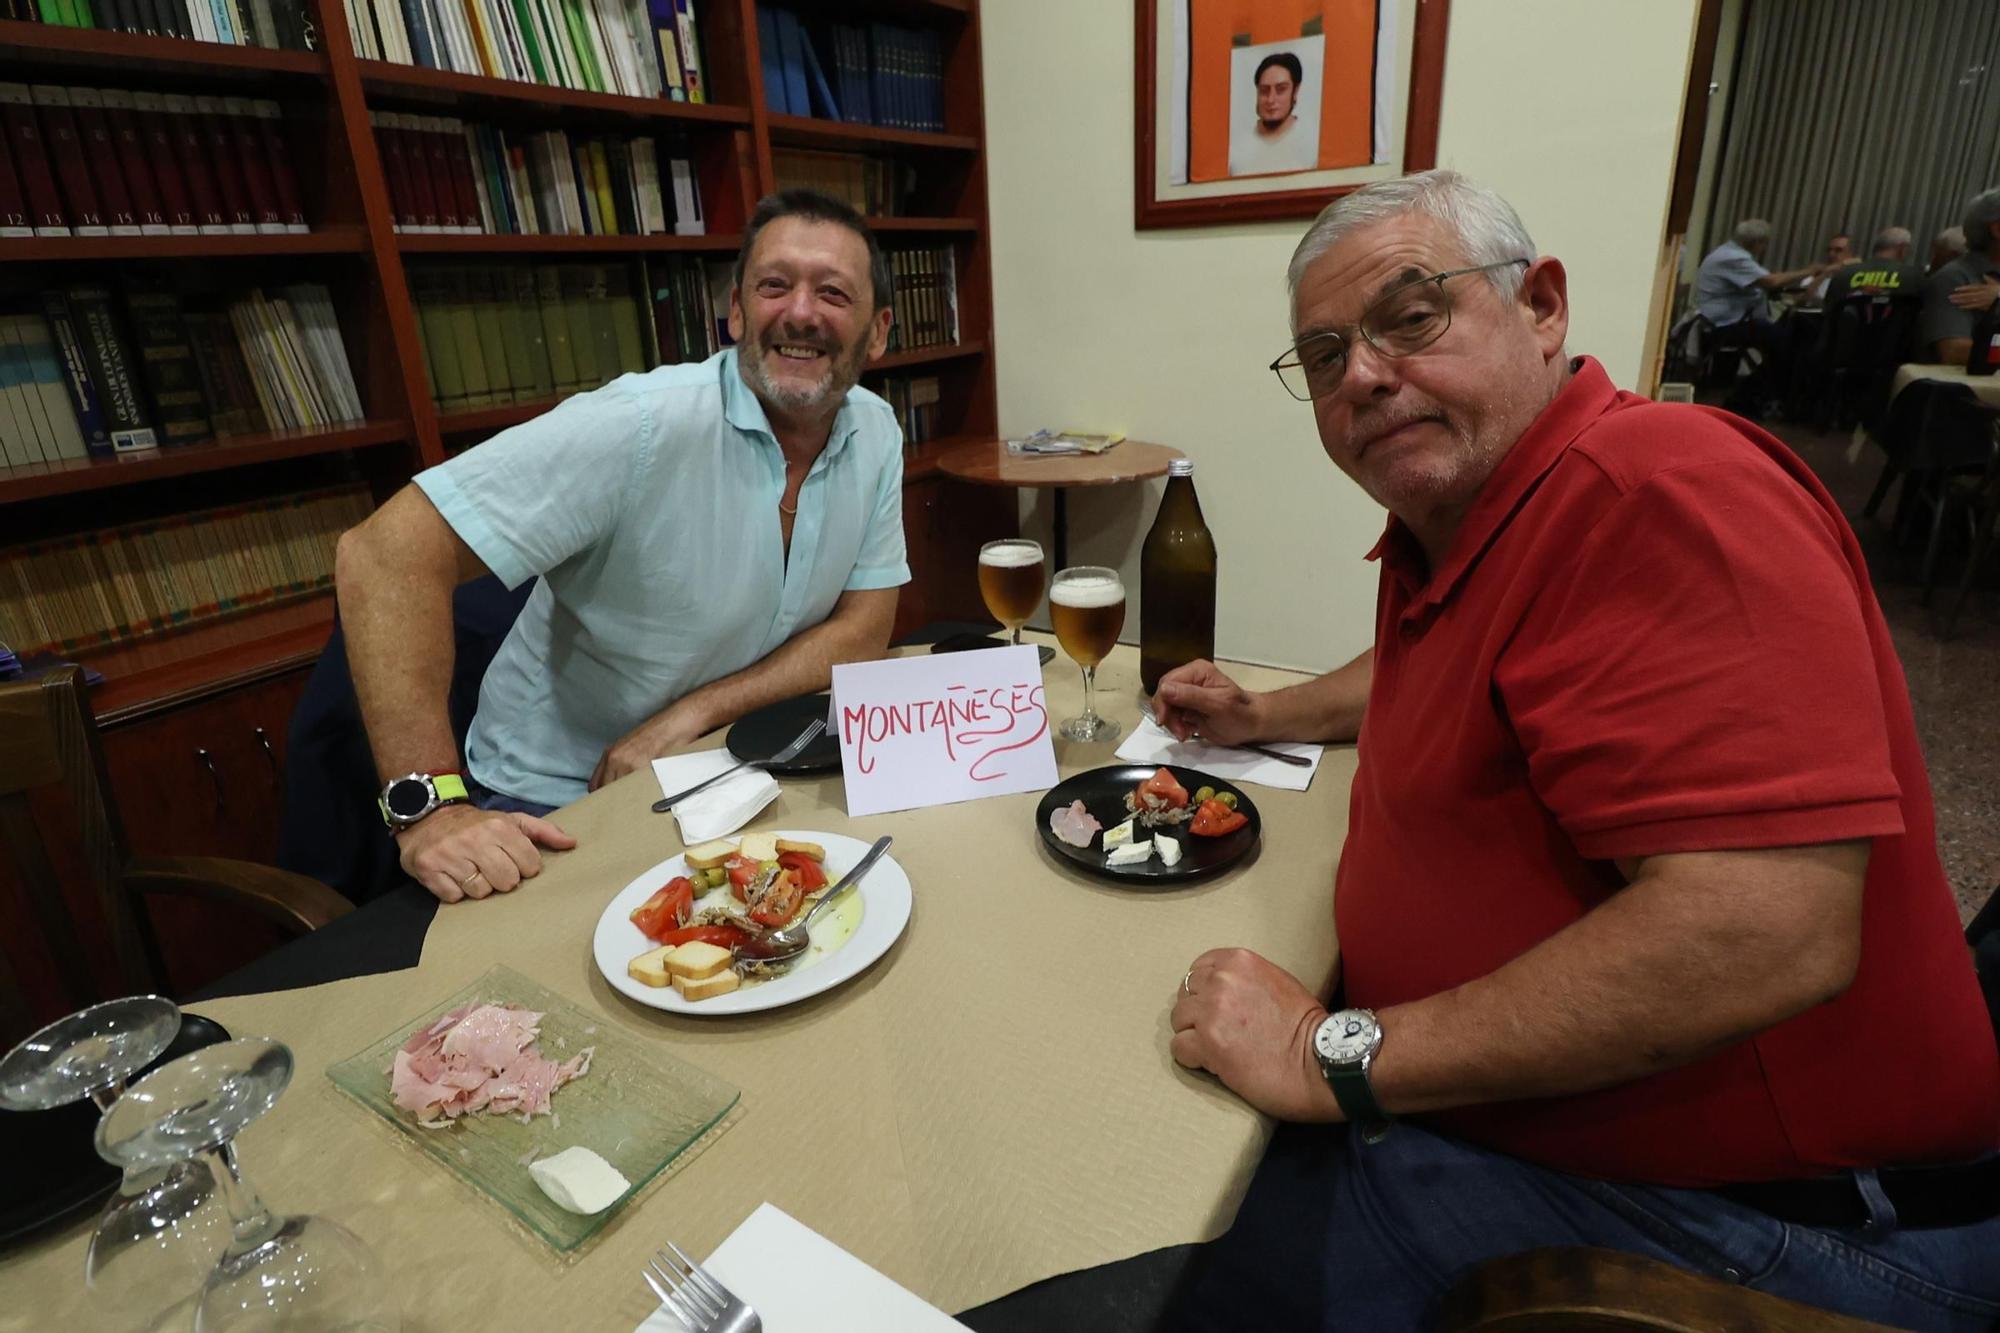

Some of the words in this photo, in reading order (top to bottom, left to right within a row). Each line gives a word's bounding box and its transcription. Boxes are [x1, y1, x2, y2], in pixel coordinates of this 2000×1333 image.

[7, 213, 25, 225] 12
[45, 213, 62, 225] 13
[83, 213, 100, 225] 14
[117, 211, 134, 225] 15
[146, 211, 162, 224] 16
[177, 212, 191, 224] 17
[207, 212, 222, 224] 18
[235, 211, 250, 224] 19
[265, 210, 279, 223] 20
[1849, 270, 1901, 289] CHILL
[843, 684, 1049, 782] MONTAÑESES
